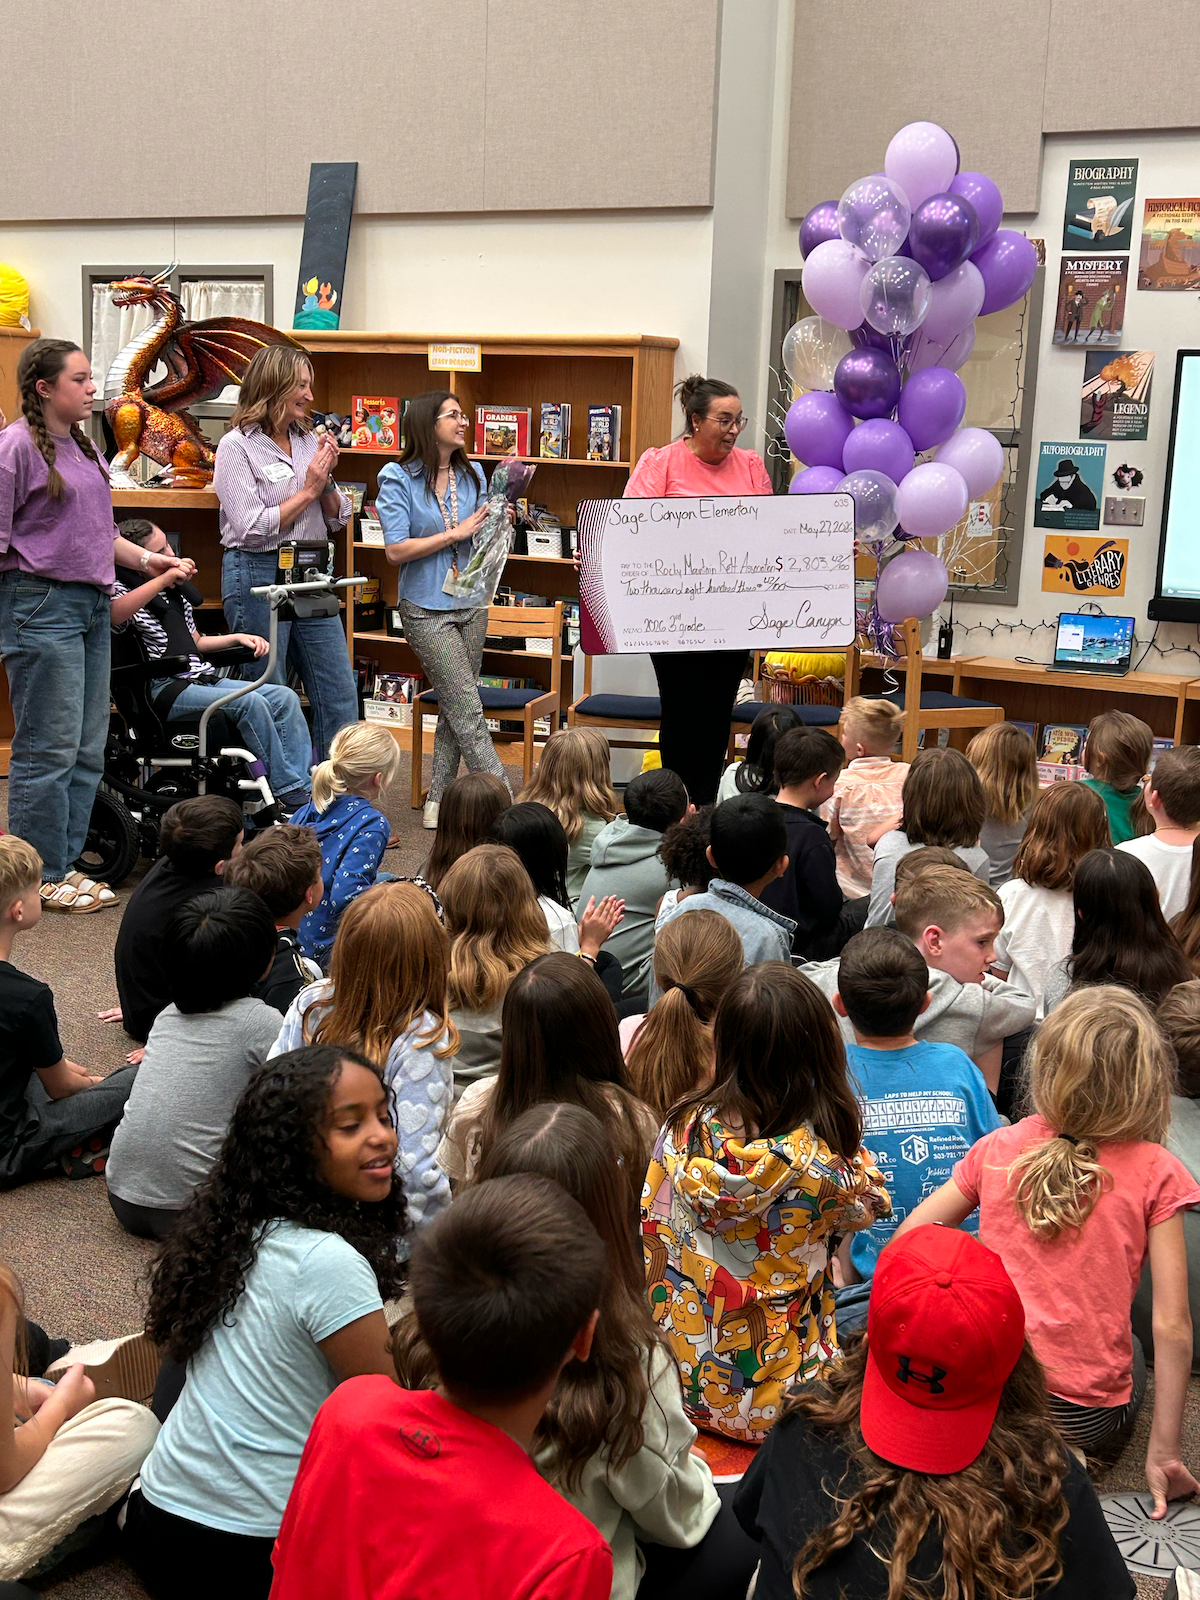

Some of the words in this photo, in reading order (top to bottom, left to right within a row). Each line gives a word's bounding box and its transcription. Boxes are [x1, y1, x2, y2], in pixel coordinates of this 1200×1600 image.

[1074, 166, 1134, 180] BIOGRAPHY
[1148, 202, 1186, 212] HISTORICAL
[1066, 260, 1123, 270] MYSTERY
[1113, 403, 1147, 414] LEGEND
[486, 414, 517, 422] GRADERS
[1041, 445, 1105, 456] AUTOBIOGRAPHY
[834, 499, 849, 507] 635
[609, 502, 648, 534] Sage
[651, 502, 697, 528] Canyon
[700, 499, 758, 520] Elementary
[800, 523, 818, 538] May
[719, 551, 737, 574] Rett
[775, 555, 783, 572] $
[1076, 551, 1122, 584] LITERARY
[1087, 570, 1120, 588] GENRES
[620, 578, 639, 595] Two
[640, 580, 684, 595] thousand
[685, 581, 705, 600] eight
[748, 602, 793, 638] Sage
[796, 600, 852, 639] Canyon
[644, 618, 667, 632] 2026
[680, 617, 705, 638] grade
[920, 1167, 950, 1181] Jessica
